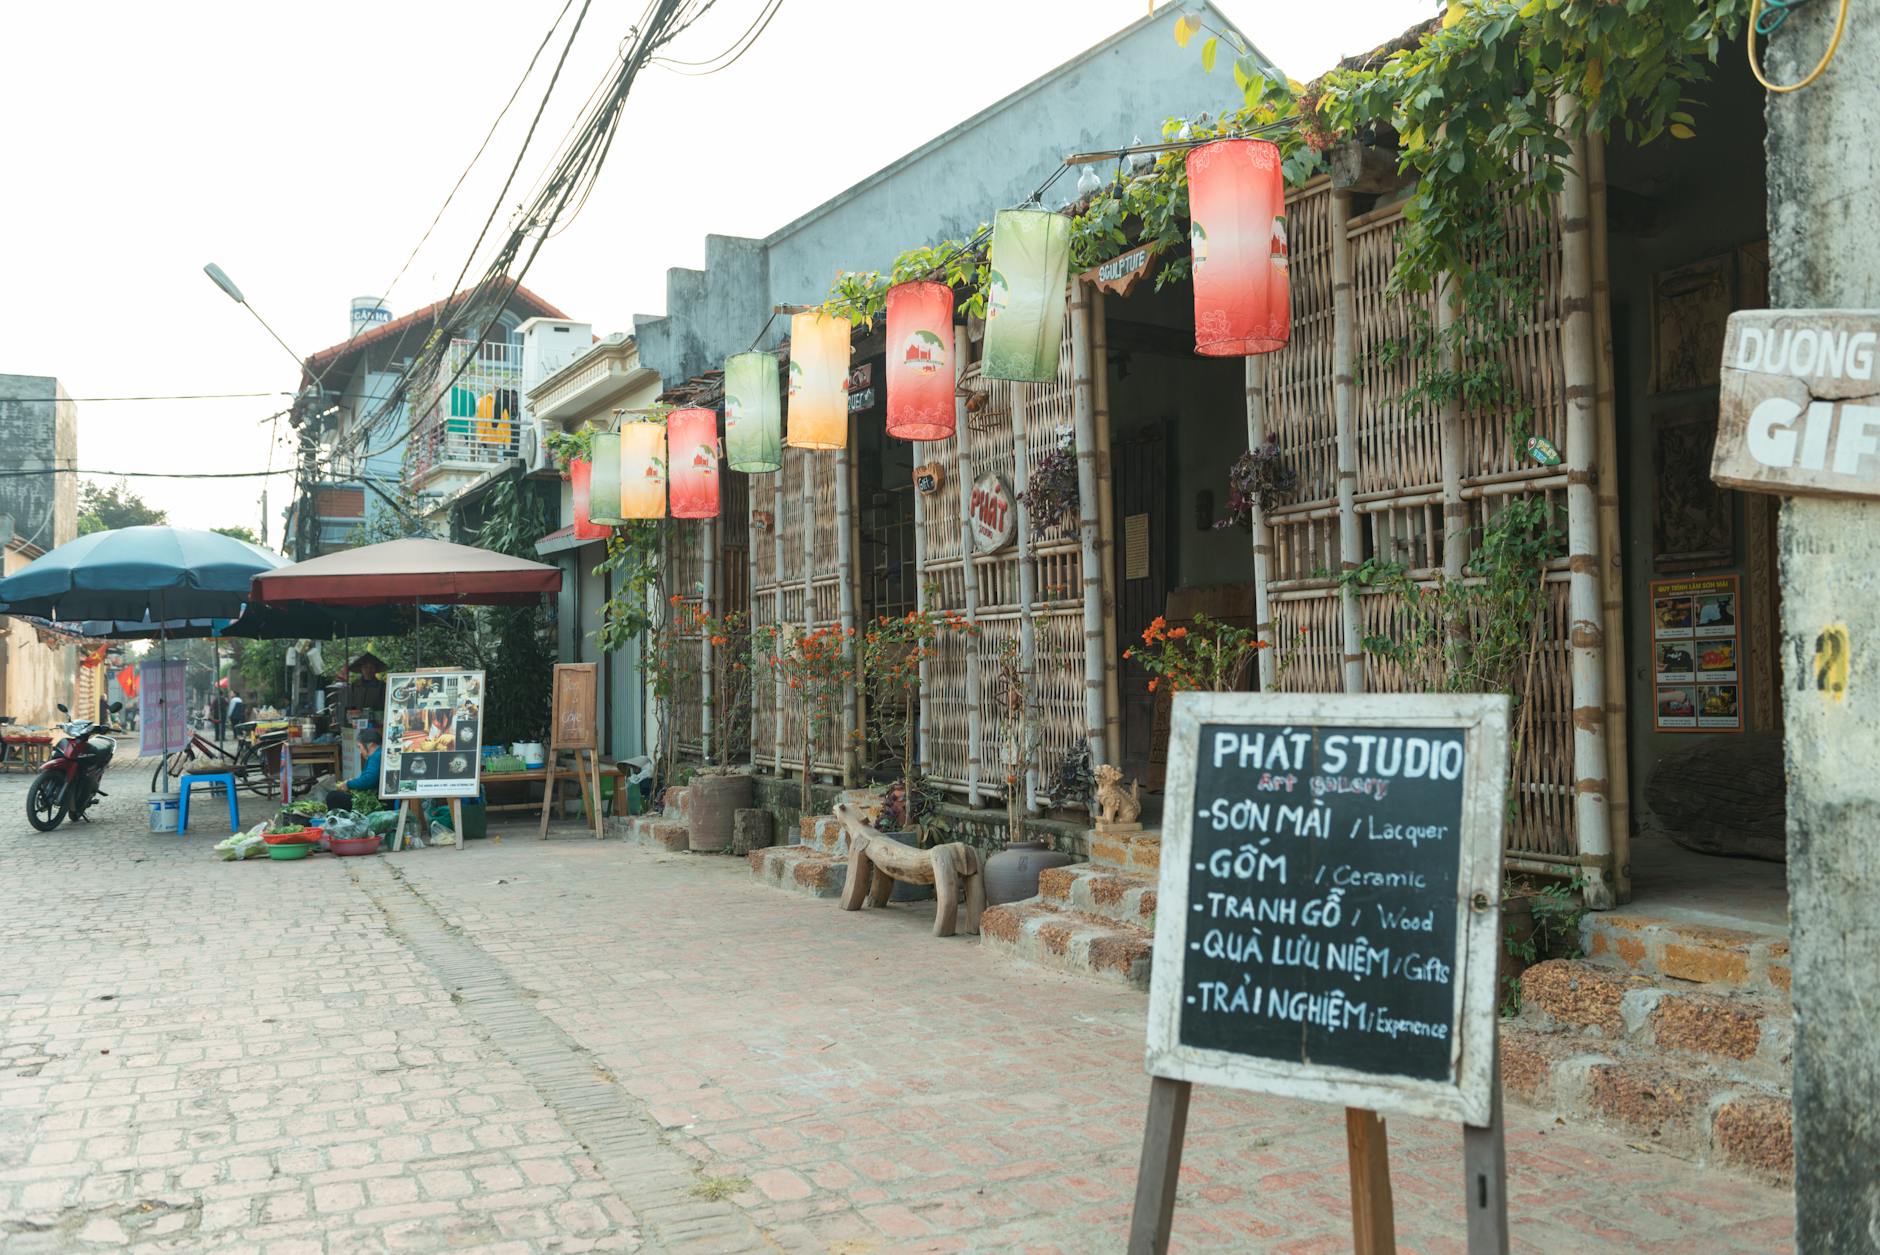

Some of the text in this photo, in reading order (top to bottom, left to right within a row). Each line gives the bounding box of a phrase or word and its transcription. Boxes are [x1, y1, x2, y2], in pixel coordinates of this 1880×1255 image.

[1736, 327, 1878, 380] DUONG
[969, 483, 1009, 534] PHÁT
[1213, 727, 1464, 781] PHÁT STUDIO
[1276, 799, 1332, 839] MÀI
[1369, 815, 1448, 849] Lacquer
[1332, 864, 1427, 888] Ceramic
[1377, 903, 1434, 932] Wood
[1326, 936, 1390, 981] NIỆM
